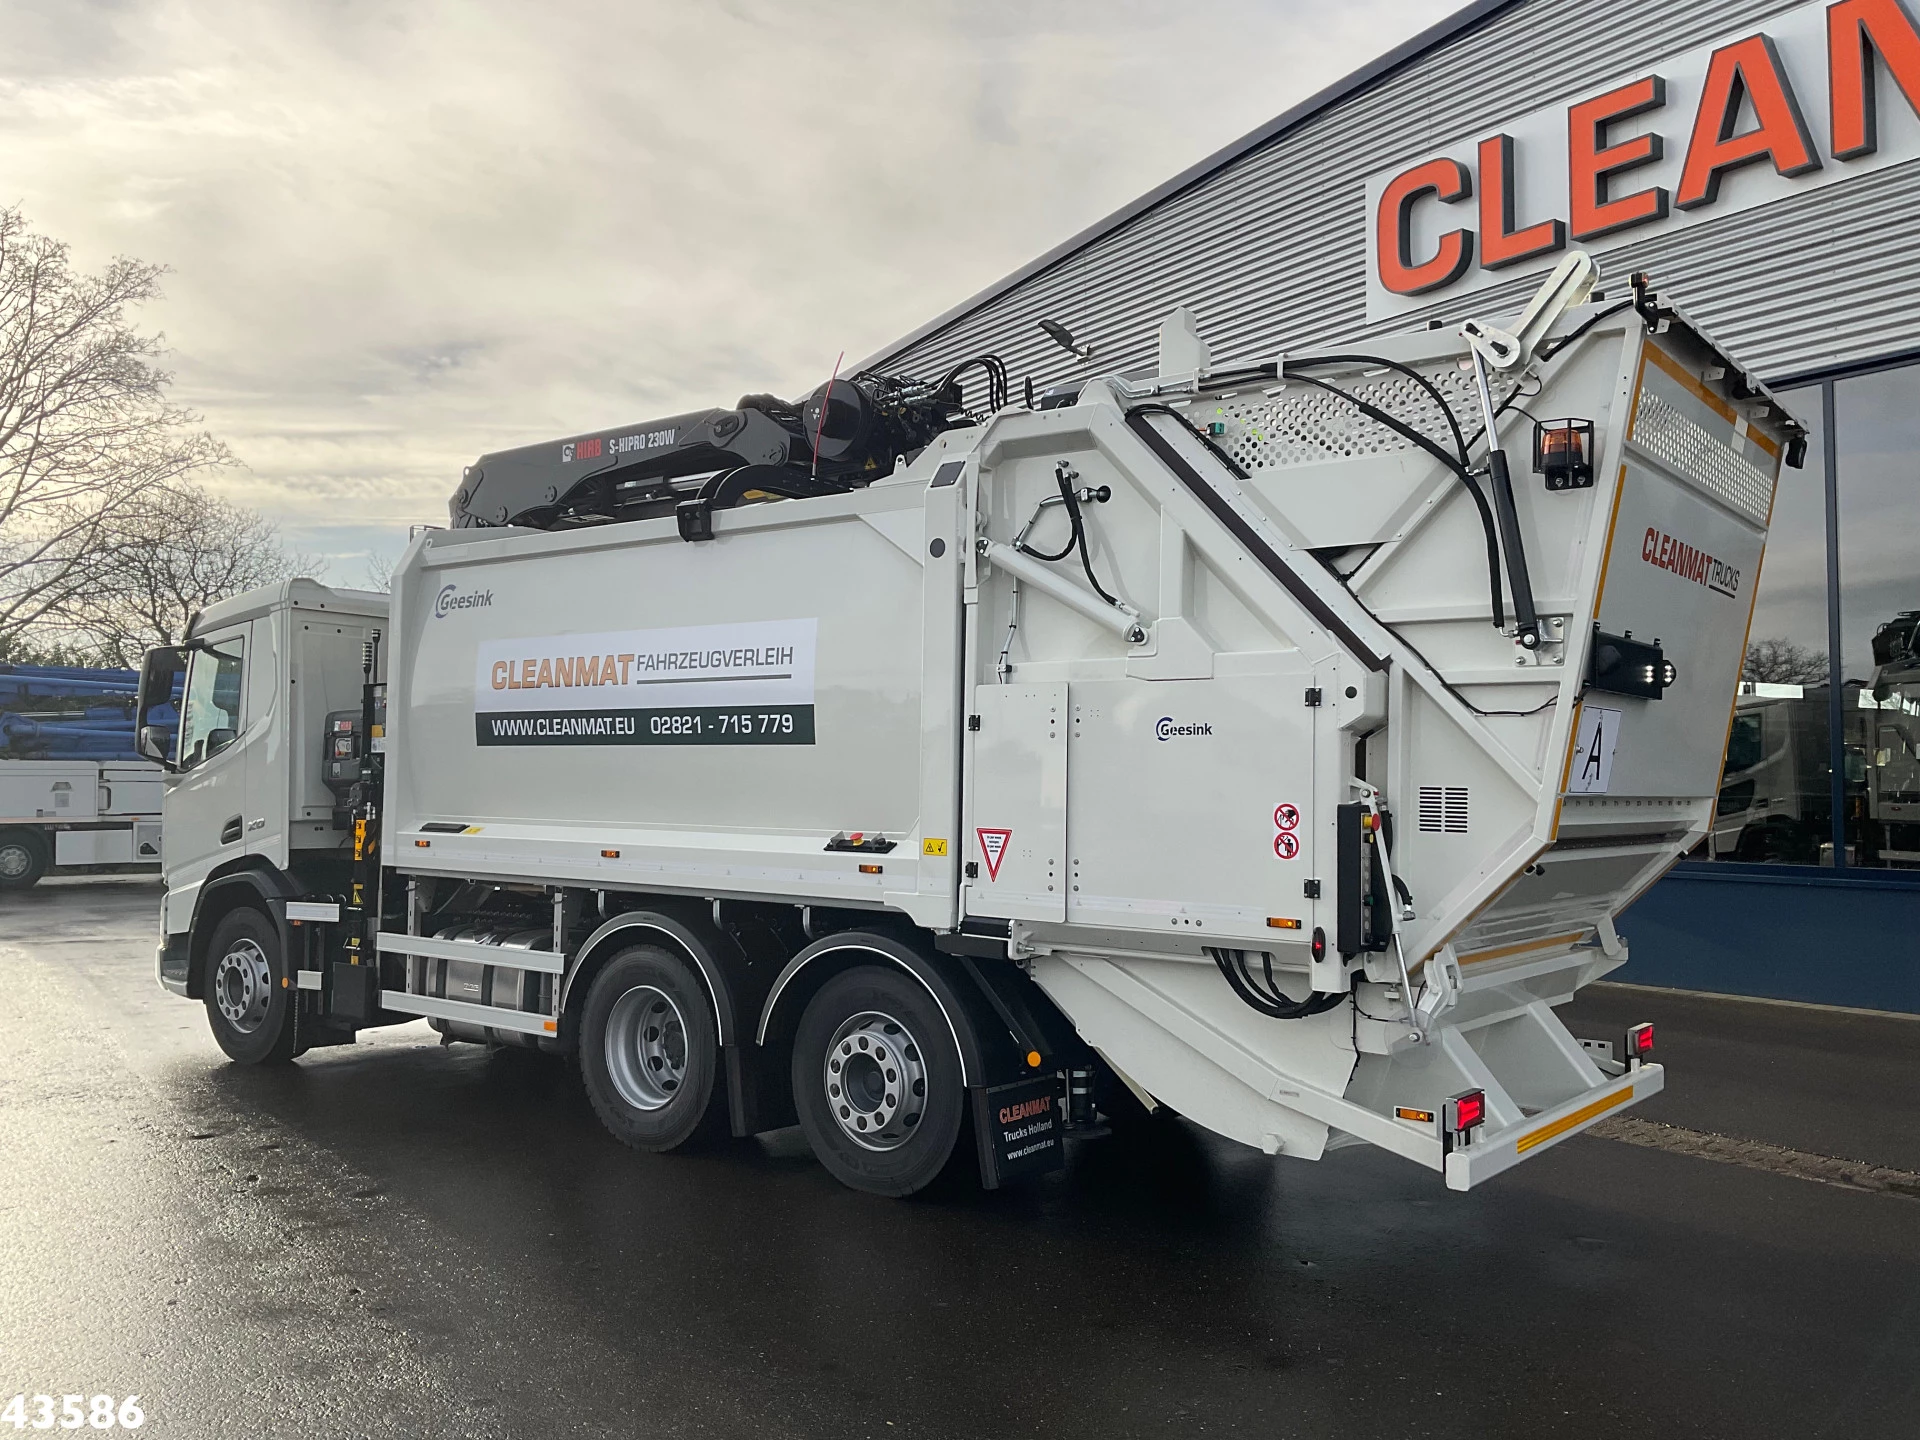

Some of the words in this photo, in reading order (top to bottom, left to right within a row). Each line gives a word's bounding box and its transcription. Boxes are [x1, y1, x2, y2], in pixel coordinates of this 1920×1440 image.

[577, 439, 601, 459] HIAB
[609, 435, 645, 454] S-HIPRO
[648, 429, 675, 447] 230W
[1642, 527, 1713, 586] CLEANMAT
[1712, 558, 1740, 591] TRUCKS
[436, 584, 494, 618] Geesink
[491, 654, 634, 690] CLEANMAT
[637, 646, 793, 671] FAHRZEUGVERLEIH
[491, 717, 635, 736] WWW.CLEANMAT.EU
[650, 715, 702, 734] 02821
[718, 714, 752, 734] 715
[758, 713, 793, 733] 779
[1156, 716, 1212, 741] Geesink
[1581, 721, 1602, 780] A
[1000, 1096, 1051, 1124] CLEANMAT
[1003, 1128, 1028, 1142] Trucks
[1028, 1118, 1053, 1136] Holland
[1007, 1139, 1055, 1160] www.cleanmat.eu
